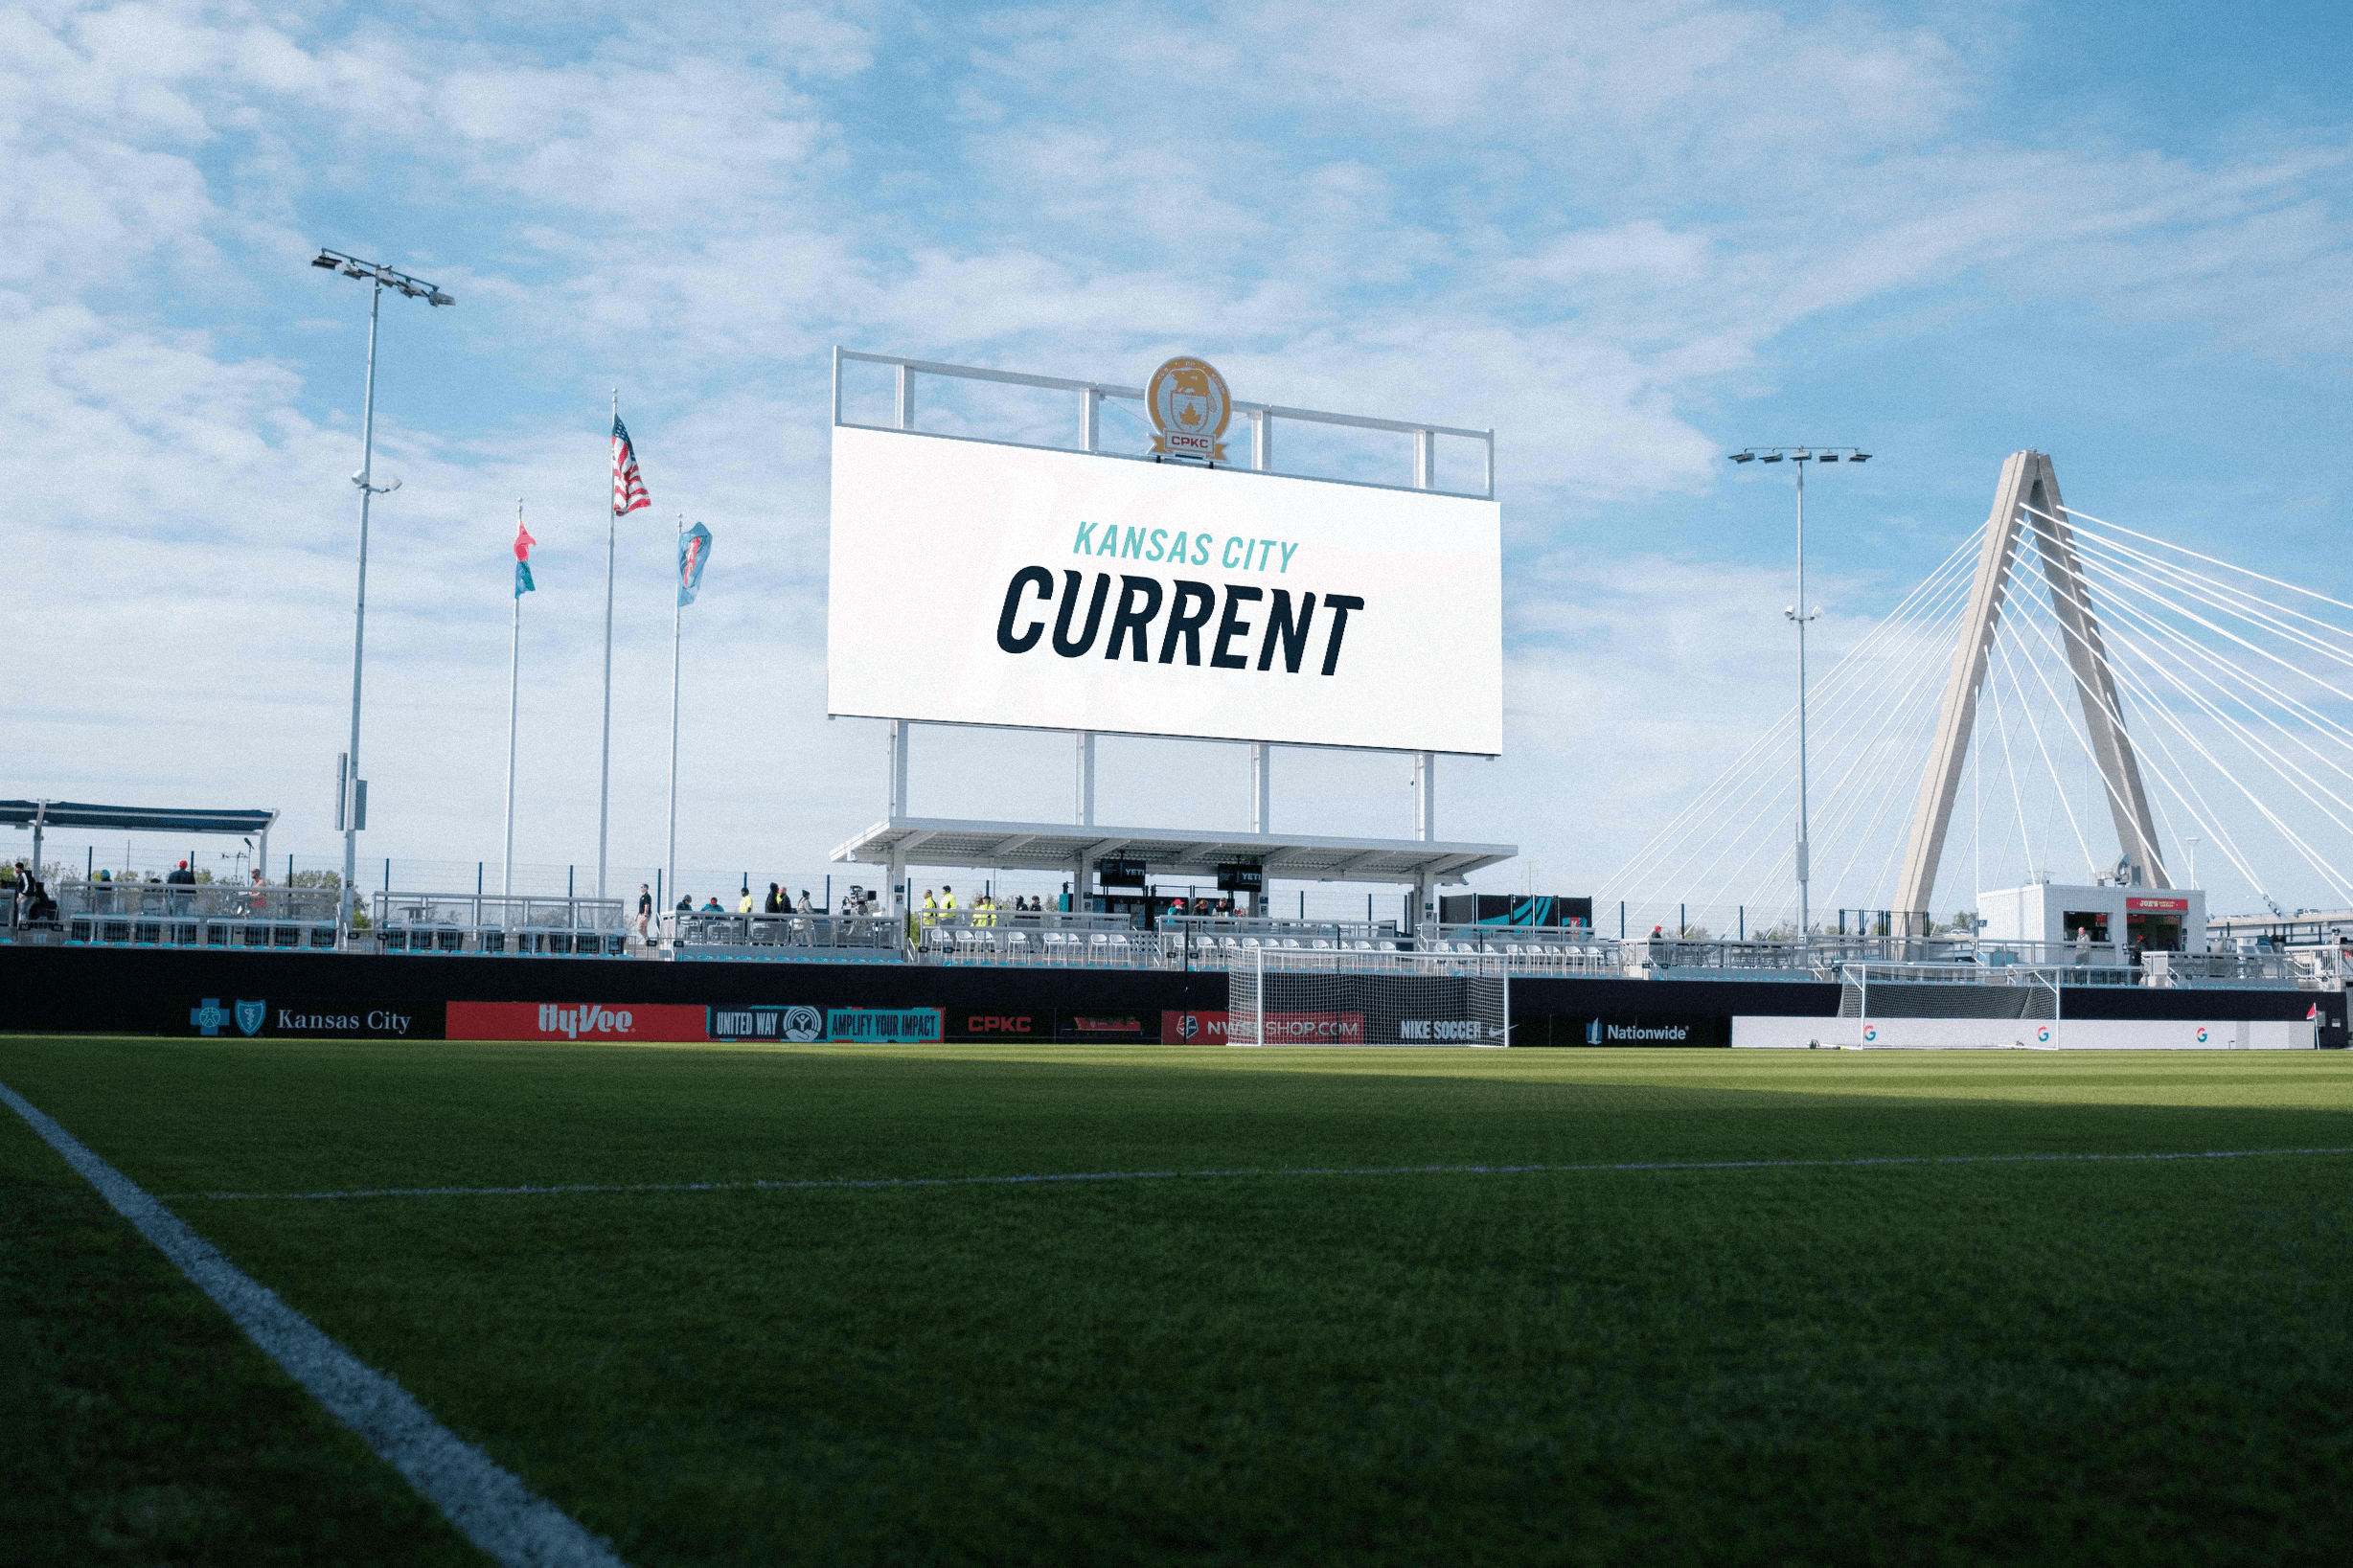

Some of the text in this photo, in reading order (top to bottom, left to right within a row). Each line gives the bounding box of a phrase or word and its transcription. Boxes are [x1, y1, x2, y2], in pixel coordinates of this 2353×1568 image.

[1171, 435, 1209, 448] CPKC
[1072, 521, 1300, 574] KANSAS CITY
[996, 565, 1365, 677] CURRENT
[1125, 868, 1145, 876] YETI
[277, 1009, 412, 1035] Kansas City
[716, 1011, 778, 1035] UNITED WAY
[831, 1013, 936, 1037] AMPLIFY YOUR IMPACT
[968, 1015, 1032, 1033] CPKC
[1207, 1021, 1358, 1036] NWSHOP.COM
[1401, 1020, 1481, 1040] NIKE SOCCER
[1607, 1024, 1687, 1040] Nationwide
